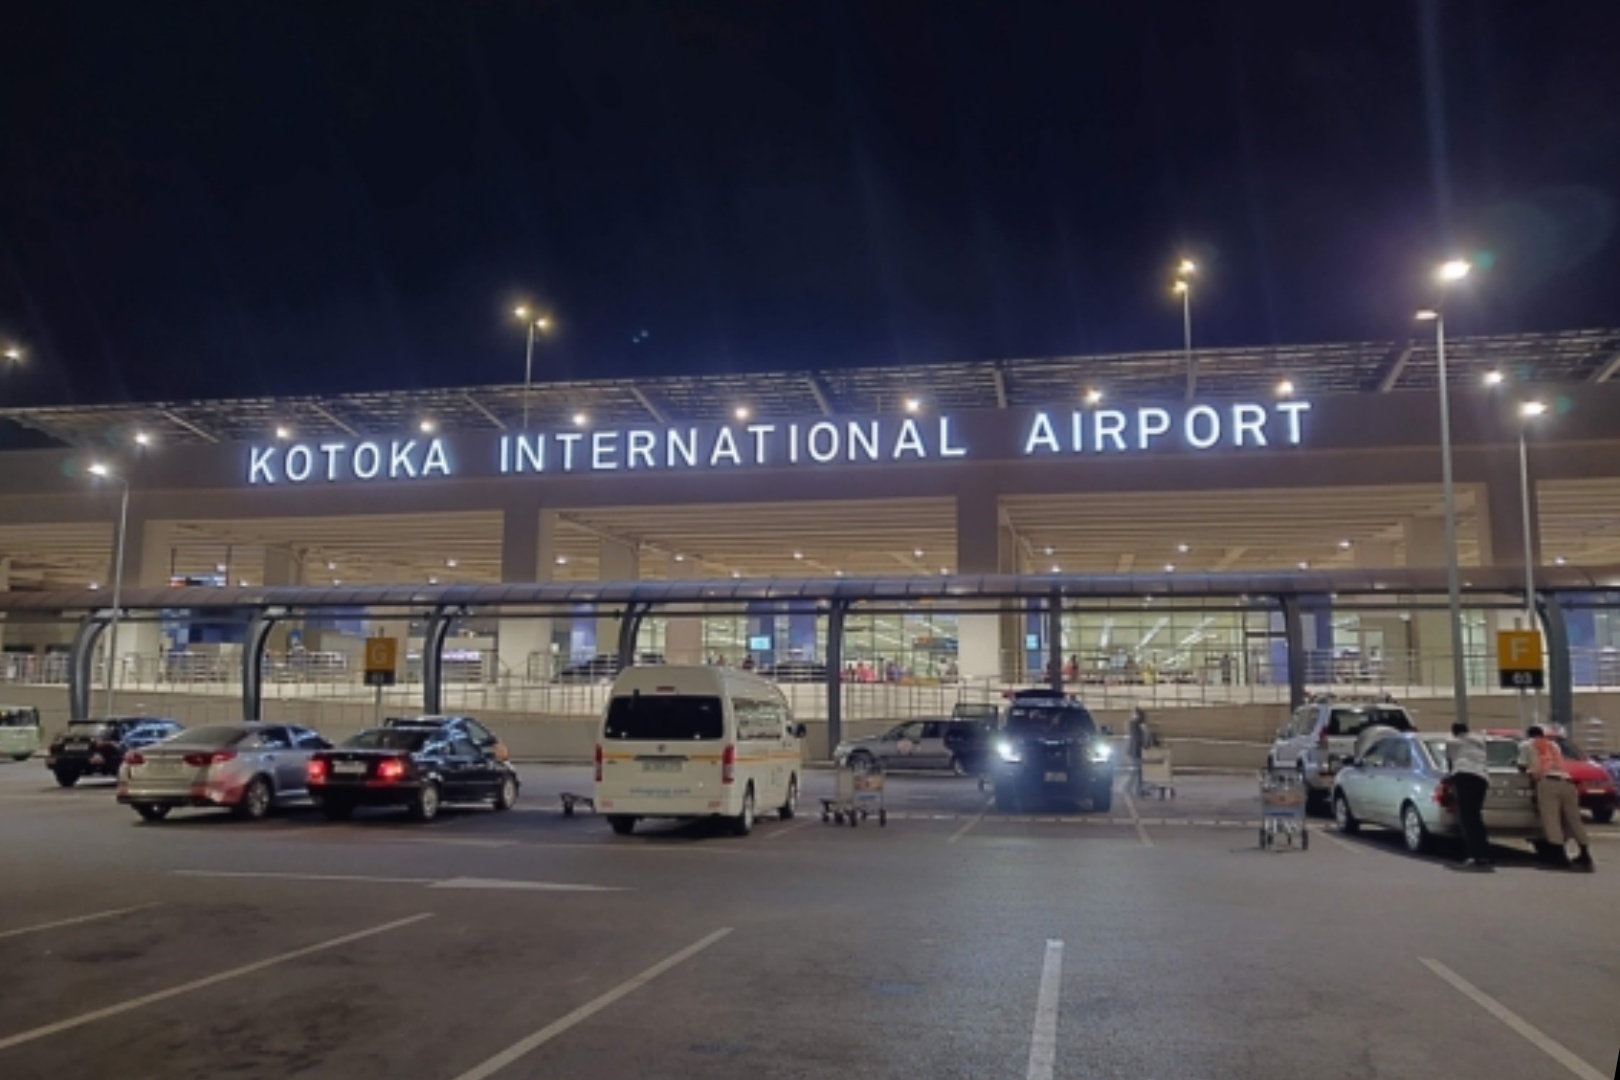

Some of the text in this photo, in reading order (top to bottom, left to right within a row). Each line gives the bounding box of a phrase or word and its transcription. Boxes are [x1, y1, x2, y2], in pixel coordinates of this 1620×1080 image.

[248, 401, 1312, 484] KOTOKA INTERNATIONAL AIRPORT
[371, 642, 387, 664] G
[1510, 636, 1530, 662] F
